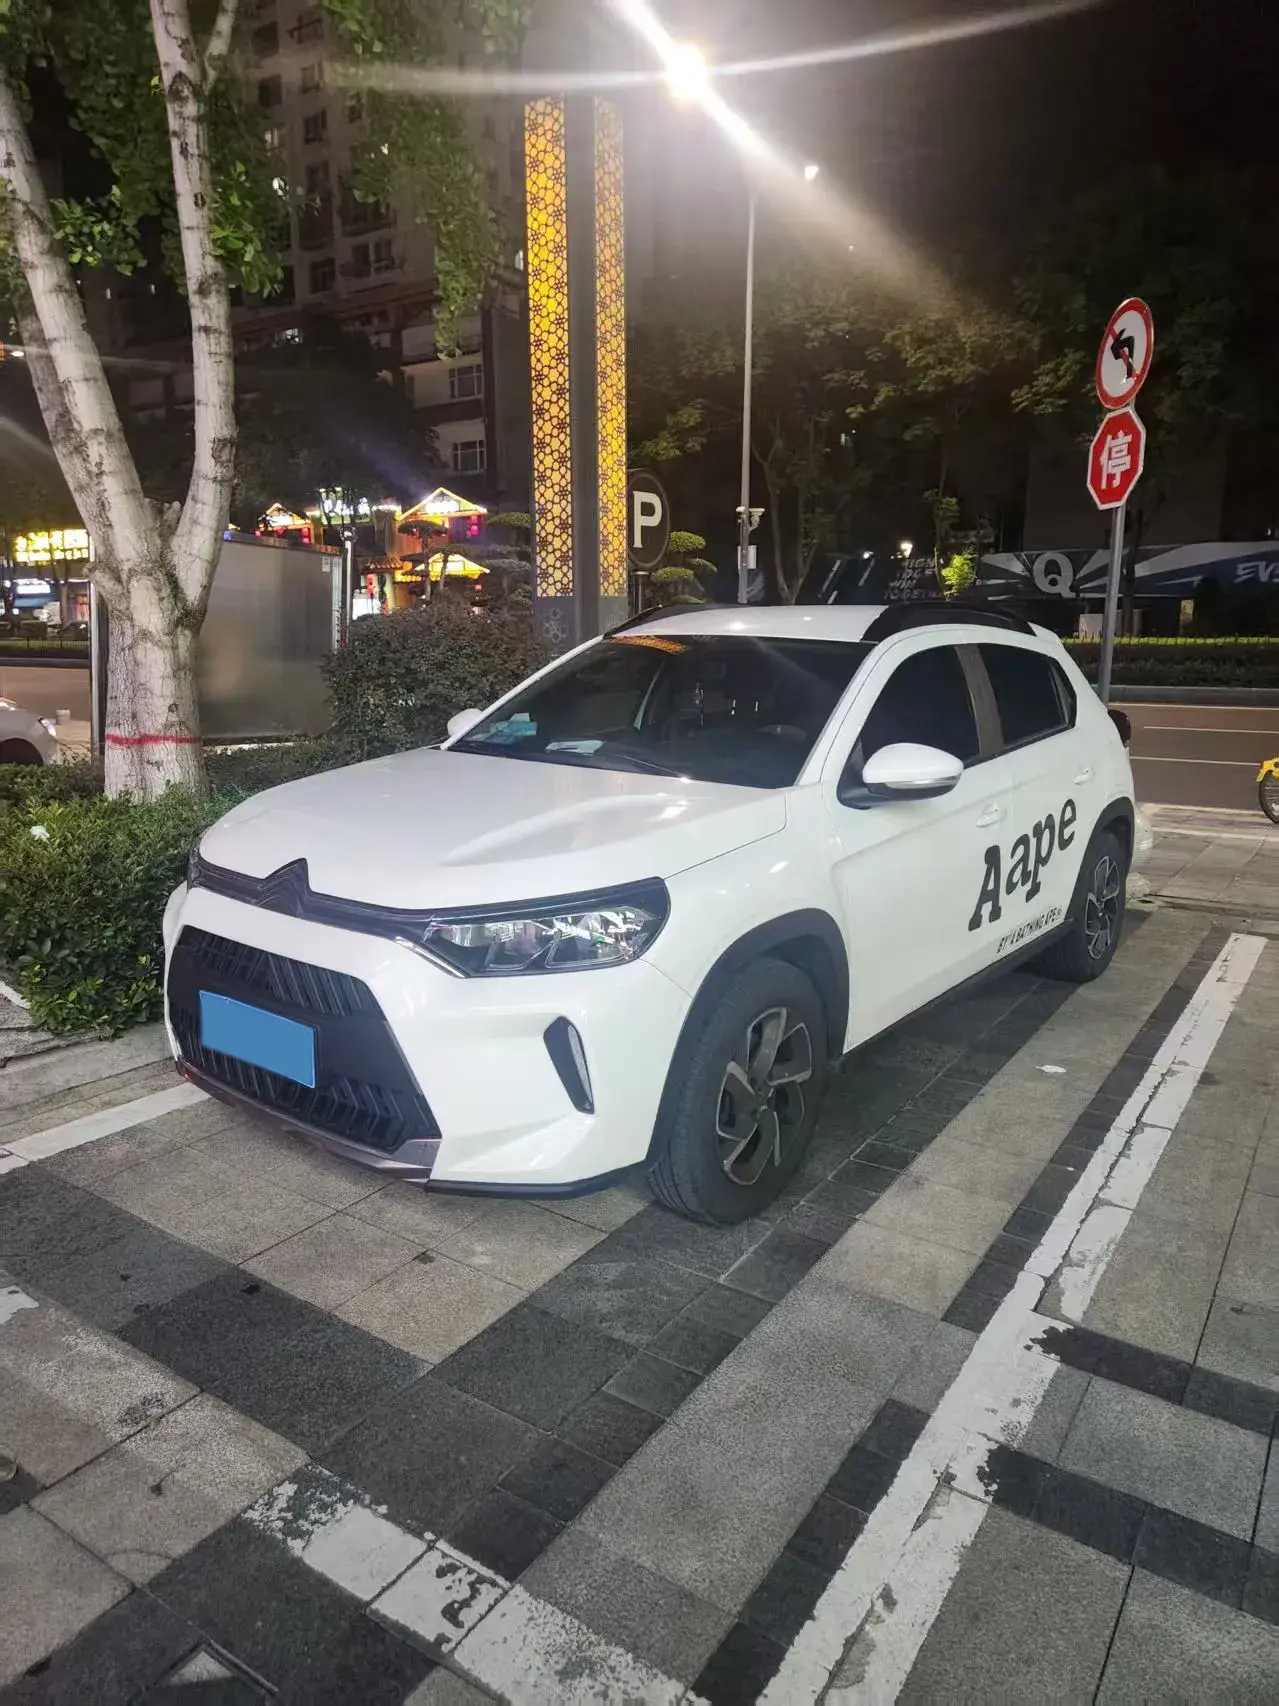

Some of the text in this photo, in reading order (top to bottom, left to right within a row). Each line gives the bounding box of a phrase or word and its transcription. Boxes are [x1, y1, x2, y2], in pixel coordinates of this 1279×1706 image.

[1100, 430, 1133, 490] 停
[633, 491, 662, 548] P
[1033, 552, 1079, 598] Q
[968, 799, 1077, 932] Aape
